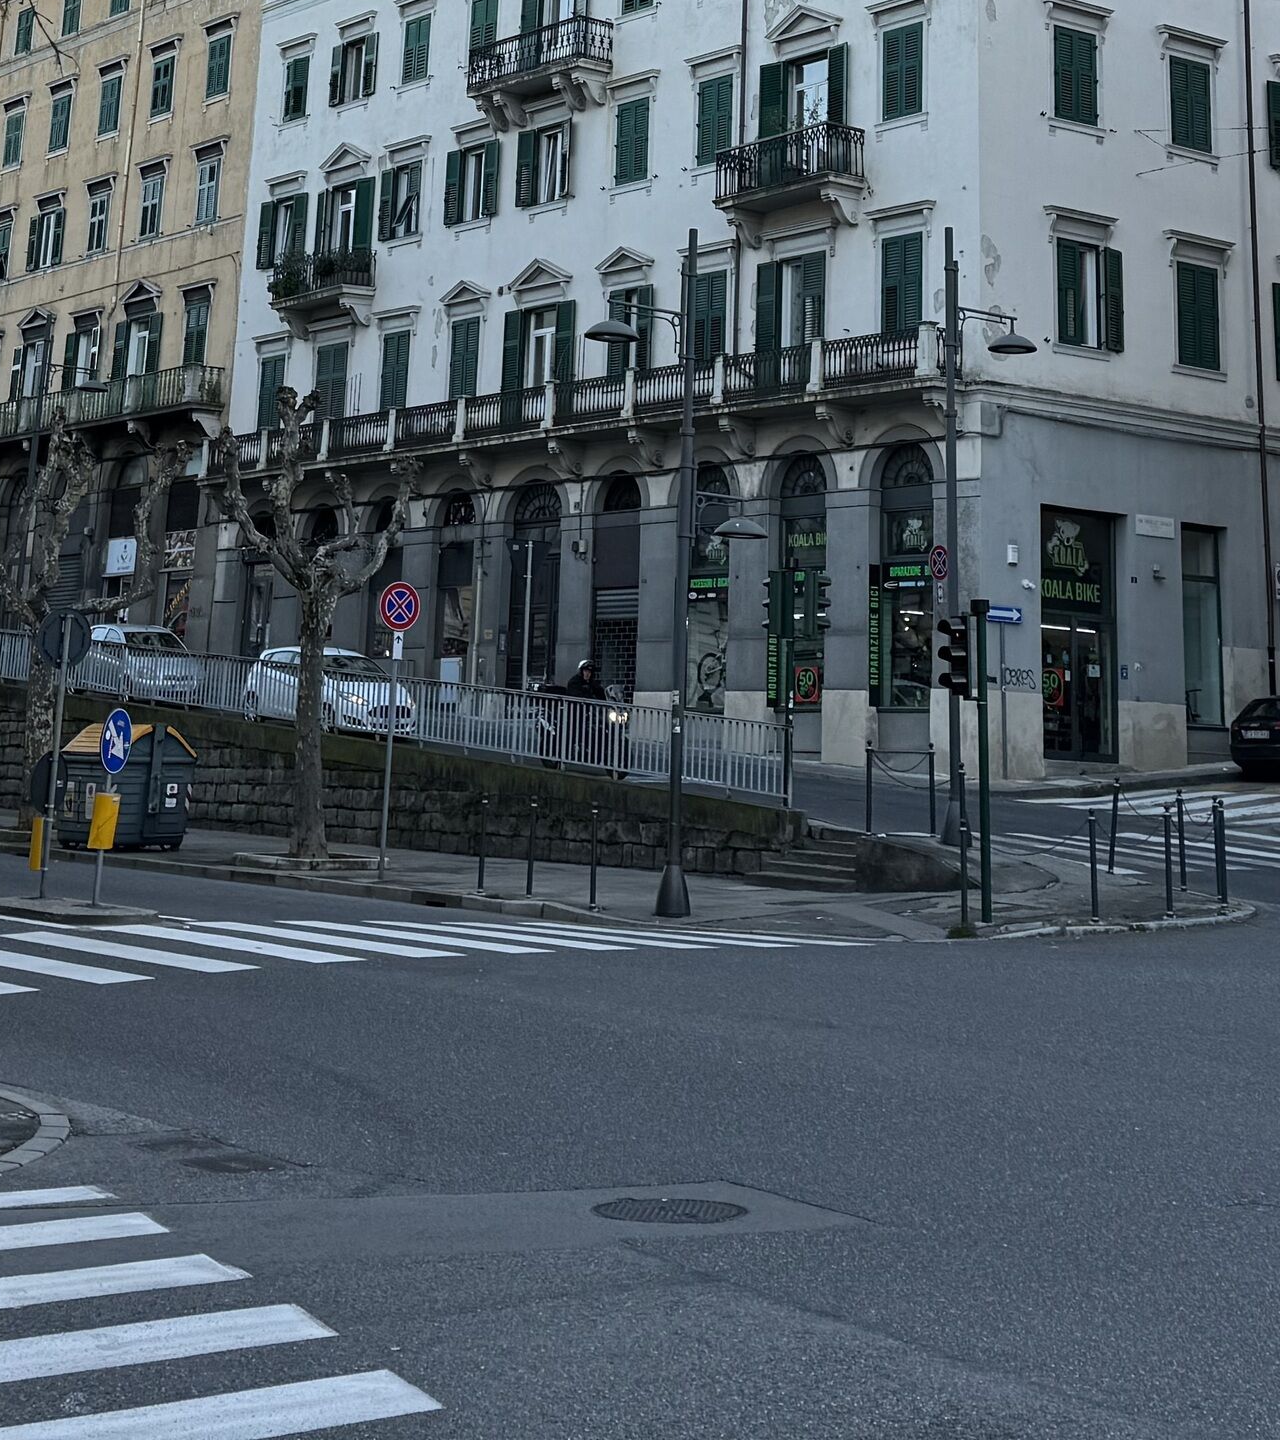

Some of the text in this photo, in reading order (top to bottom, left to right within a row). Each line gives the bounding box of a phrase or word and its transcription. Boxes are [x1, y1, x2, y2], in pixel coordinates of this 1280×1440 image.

[788, 533, 813, 548] KOALA
[1053, 546, 1084, 566] KOALA
[870, 585, 879, 608] BICI
[1076, 581, 1101, 603] BIKE
[768, 633, 778, 699] MOUNTAINBI
